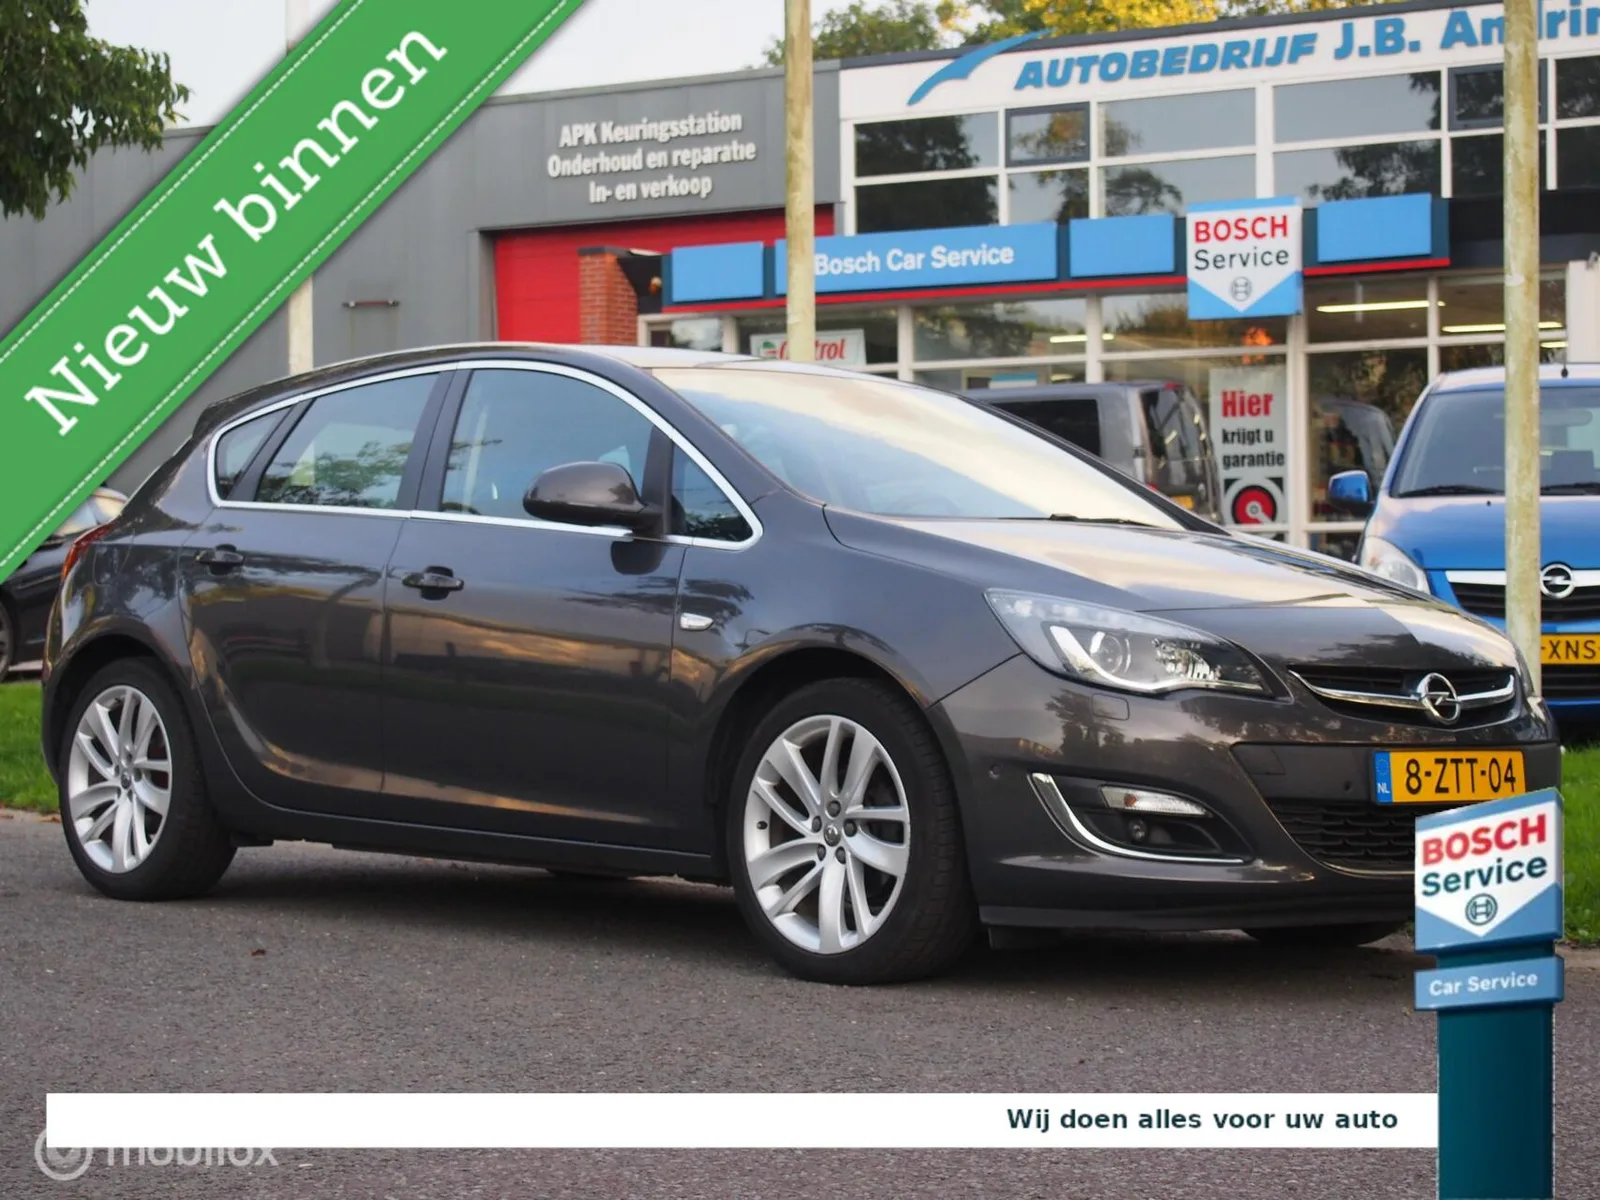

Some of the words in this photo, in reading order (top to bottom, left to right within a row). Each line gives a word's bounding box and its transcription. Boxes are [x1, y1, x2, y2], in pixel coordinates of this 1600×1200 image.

[1014, 32, 1318, 91] AUTOBEDRIJF
[1334, 17, 1421, 60] J.B.
[558, 122, 598, 147] APK
[600, 111, 742, 143] Keuringsstation
[547, 148, 644, 178] Onderhoud
[646, 150, 668, 169] en
[672, 139, 757, 170] reparatie
[589, 181, 613, 203] In-
[615, 181, 637, 201] en
[640, 174, 712, 199] verkoop
[1194, 215, 1288, 244] BOSCH
[814, 251, 881, 276] Bosch
[886, 248, 925, 271] Car
[930, 244, 1014, 269] Service
[1194, 246, 1289, 271] Service
[1221, 389, 1274, 418] Hier
[1222, 428, 1261, 446] krijgt
[1265, 429, 1273, 443] u
[1222, 450, 1285, 470] garantie
[1376, 782, 1390, 794] NL
[1405, 757, 1517, 795] 8-ZTT-04
